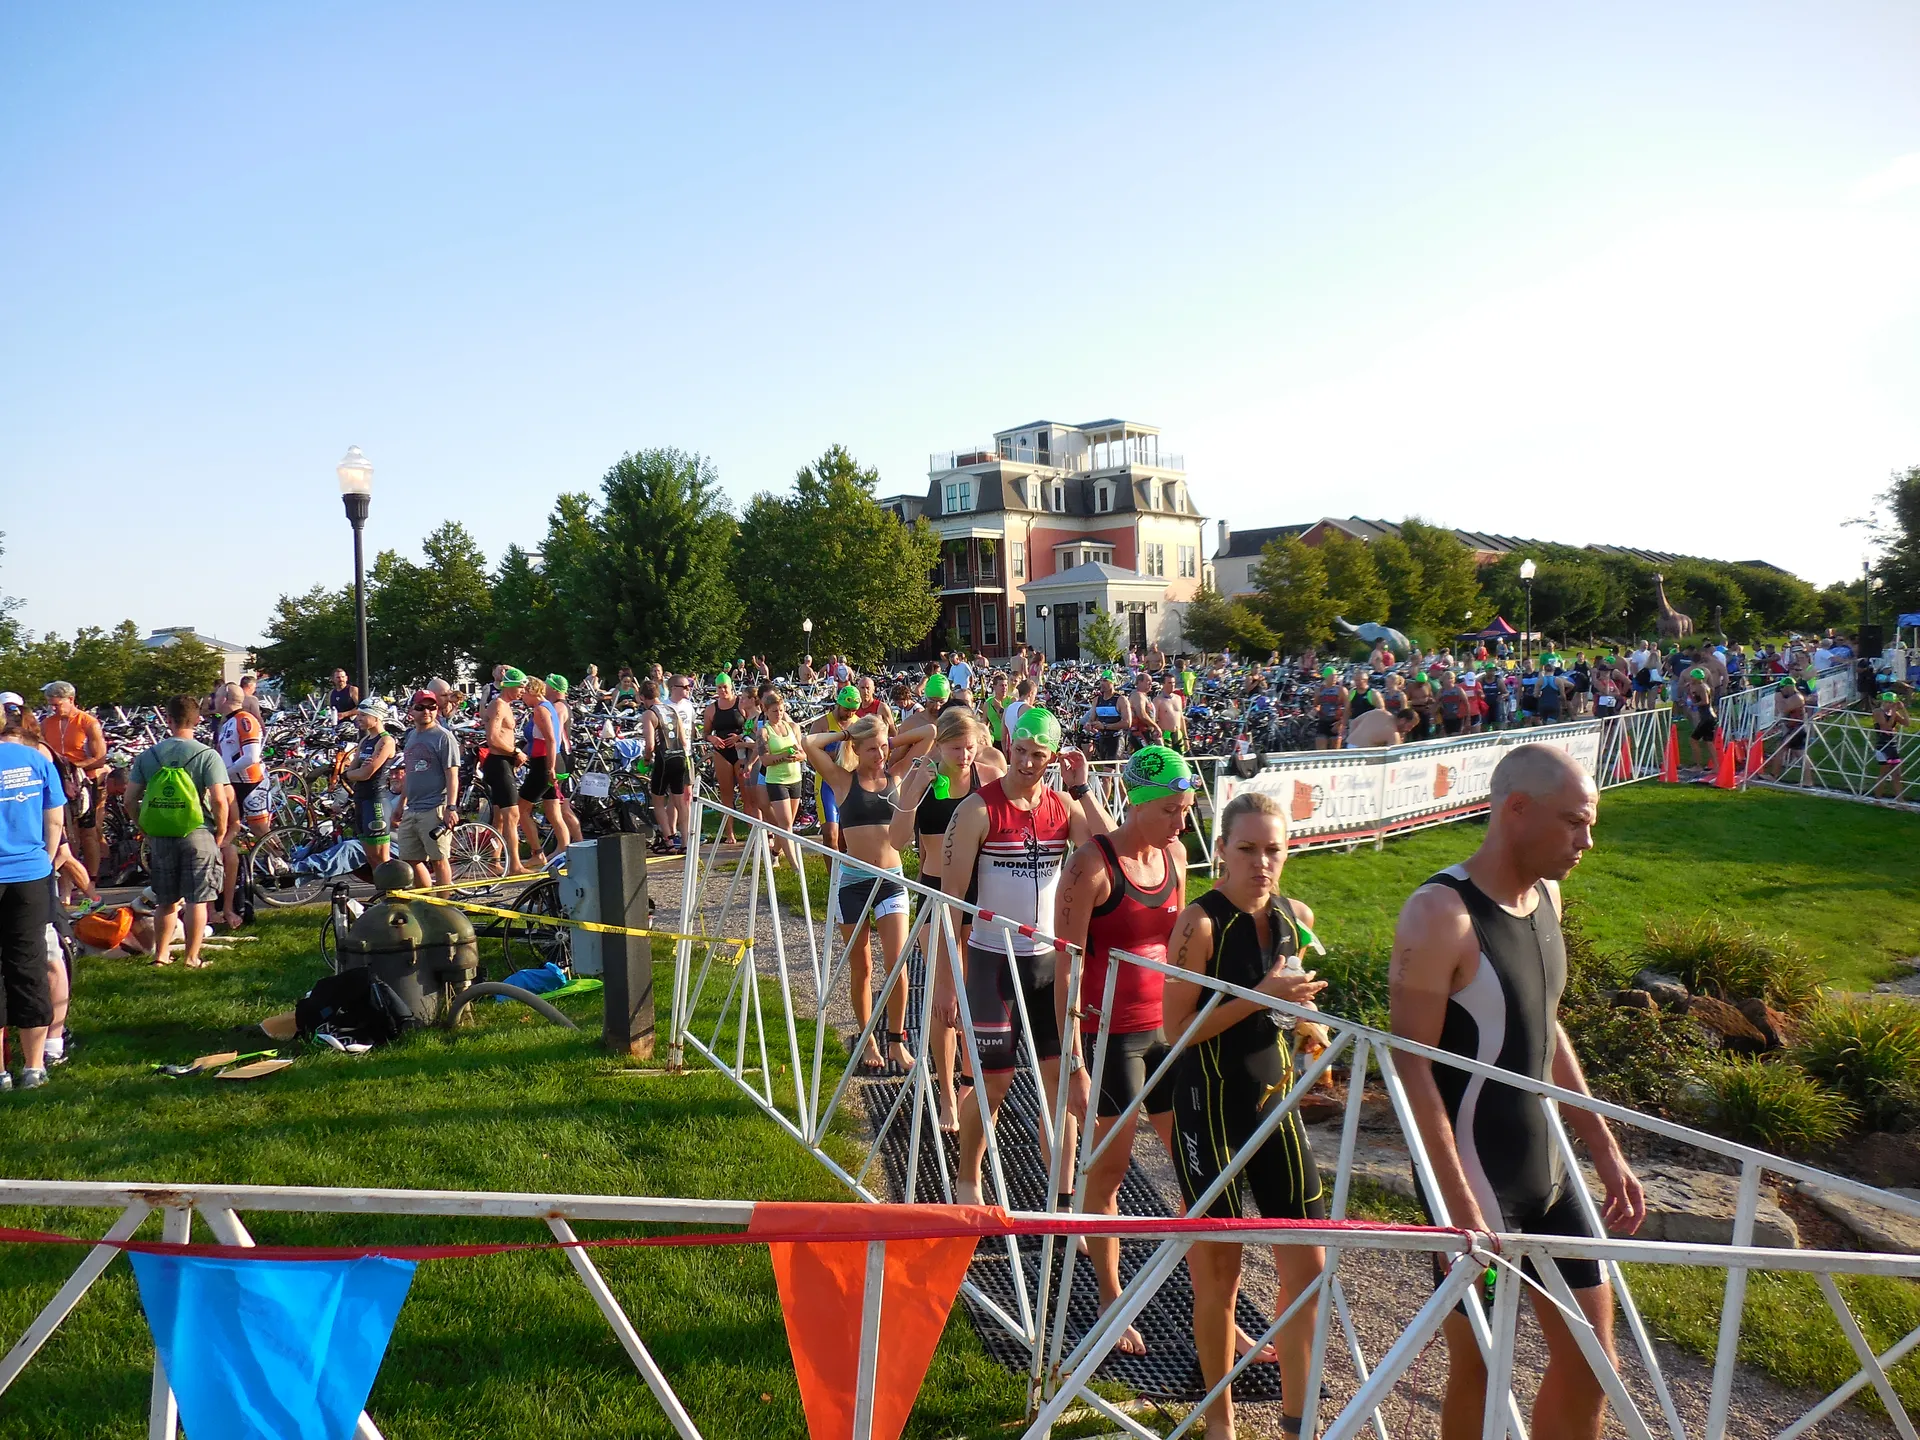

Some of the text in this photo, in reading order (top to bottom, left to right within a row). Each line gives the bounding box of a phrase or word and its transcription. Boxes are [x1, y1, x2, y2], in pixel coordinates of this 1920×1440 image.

[1456, 772, 1492, 795] ULTR
[1325, 795, 1378, 818] ULTRA
[1011, 868, 1053, 879] RACING
[1062, 864, 1083, 925] 469
